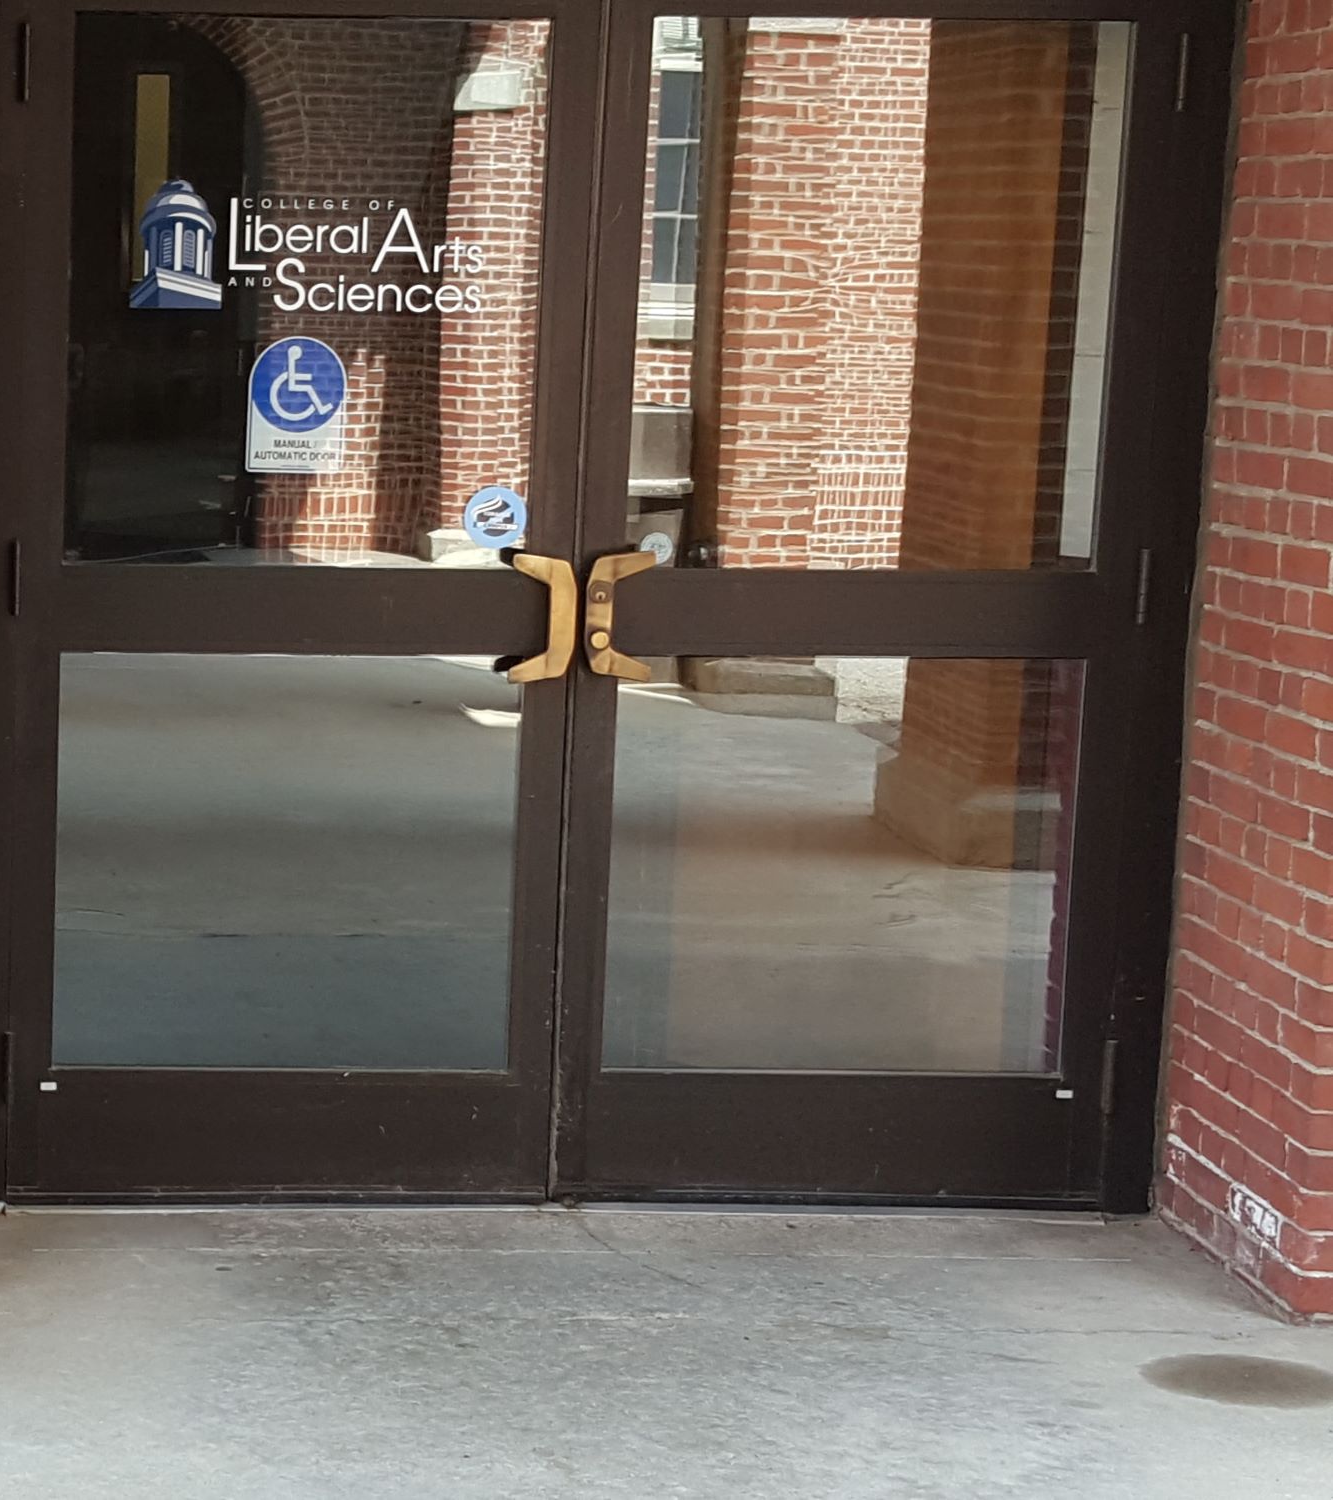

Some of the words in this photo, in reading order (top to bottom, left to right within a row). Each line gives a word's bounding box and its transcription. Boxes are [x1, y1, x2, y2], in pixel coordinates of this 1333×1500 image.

[242, 198, 350, 210] COLLEGE
[368, 200, 395, 211] OF
[228, 197, 369, 271] Liberal
[370, 208, 484, 274] Arts
[228, 276, 272, 287] AND
[273, 257, 482, 314] Sciences
[273, 439, 312, 449] MANUAL
[253, 450, 307, 461] AUTOMATIC
[309, 451, 337, 462] DOOR
